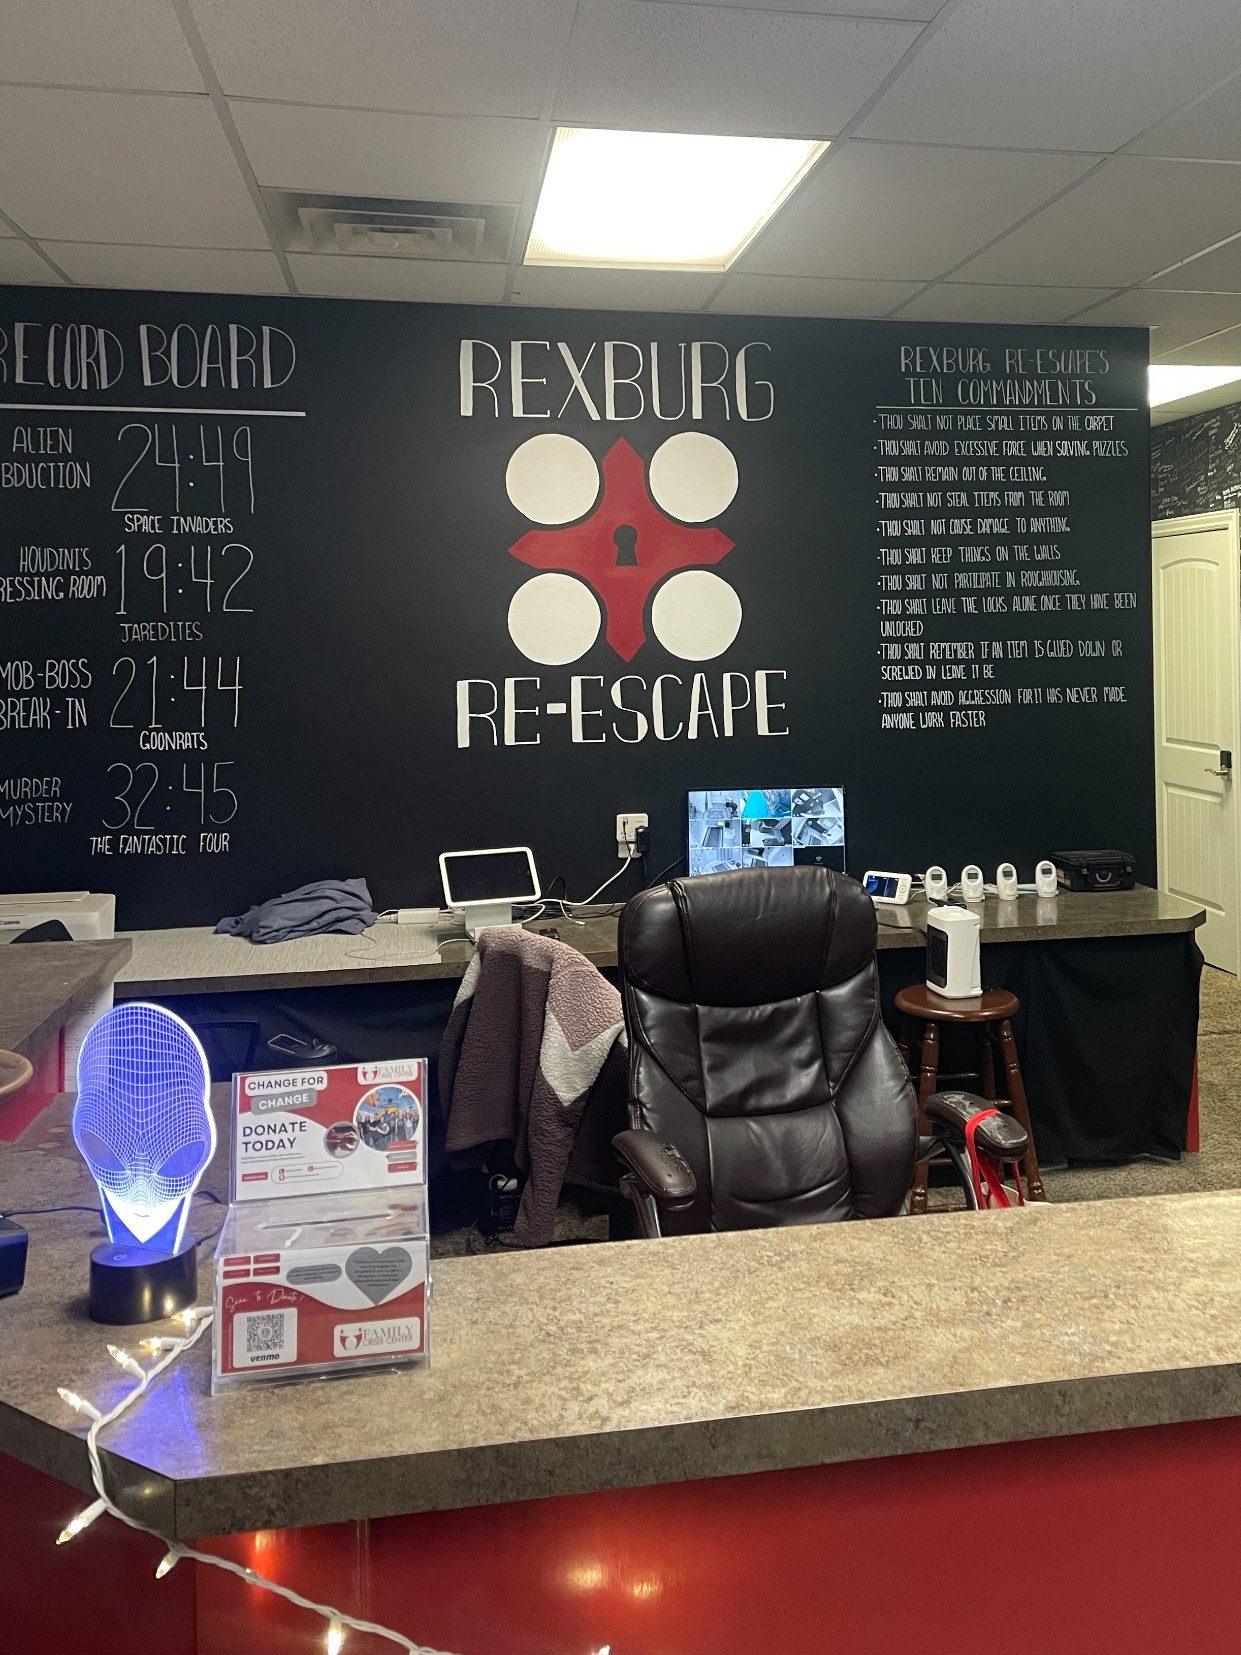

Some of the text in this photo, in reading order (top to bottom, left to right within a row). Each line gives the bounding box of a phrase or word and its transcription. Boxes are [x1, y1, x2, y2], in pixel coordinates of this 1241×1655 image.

[139, 323, 296, 389] BOARD
[900, 346, 1110, 374] REXBURG RE-ESCAPE'S
[459, 339, 775, 421] REXBURG
[905, 378, 1096, 405] TEN COMMANDMENTS
[878, 413, 1115, 431] THOU SHALT NOT PLACE SMALL ITEMS ON THE CARPET
[878, 439, 1129, 457] THOU SHALT AVOID EXCESSIVE FORCE WHEN SOLVING PUZZLES
[12, 423, 254, 514] ALIEN 24:49
[878, 466, 899, 482] THOU
[901, 466, 922, 481] SHALT
[925, 466, 958, 481] REMAIN
[962, 466, 977, 481] OUT
[979, 466, 988, 481] OF
[990, 466, 1007, 481] THE
[878, 490, 1070, 509] THOU SHALT NOT STEAL ITEMS FROM THE ROOM
[124, 514, 234, 534] SPACE INVADERS
[879, 520, 902, 537] THOU
[903, 519, 925, 535] SHALT
[931, 519, 946, 535] NOT
[950, 519, 975, 535] CAUSE
[977, 518, 1011, 534] DAMAGE
[1015, 517, 1027, 533] TO
[880, 544, 1061, 566] THOU SHALT KEEP THINGS ON THE WALLS
[19, 543, 254, 615] HOUDINI'S 19:42
[69, 575, 107, 599] ROOM
[880, 574, 902, 591] THOU
[904, 574, 927, 590] SHALT
[931, 573, 949, 590] NOT
[954, 571, 1002, 589] PARTICIPATE
[1005, 571, 1016, 588] IN
[880, 592, 1137, 615] THOU SHALT LEAVE THE LOCKS ALONE ONCE THEY HAVE BEEN
[120, 621, 204, 643] JAREDITES
[880, 620, 924, 637] UNLOCKED
[880, 640, 1123, 660] THOU SHALT REMEMBER IF AN ITEM IS GLUED DOWN OR
[881, 664, 996, 680] SCREWED IN LEAVE IT BE
[110, 656, 243, 728] 21:44
[880, 686, 1128, 708] THOU SHALT AVOID AGGRESSION FOR IT HAS NEVER MADE
[456, 670, 789, 748] RE-ESCAPE
[881, 710, 987, 730] ANYONE WORK FASTER
[139, 730, 208, 751] GOONRATS
[102, 761, 239, 830] 32:45
[89, 833, 230, 856] THE FANTASTIC FOUR
[248, 1076, 324, 1091] CHANGE FOR
[258, 1093, 310, 1110] CHANGE
[242, 1121, 307, 1137] DONATE
[242, 1137, 297, 1153] TODAY
[363, 1325, 415, 1340] FAMILY
